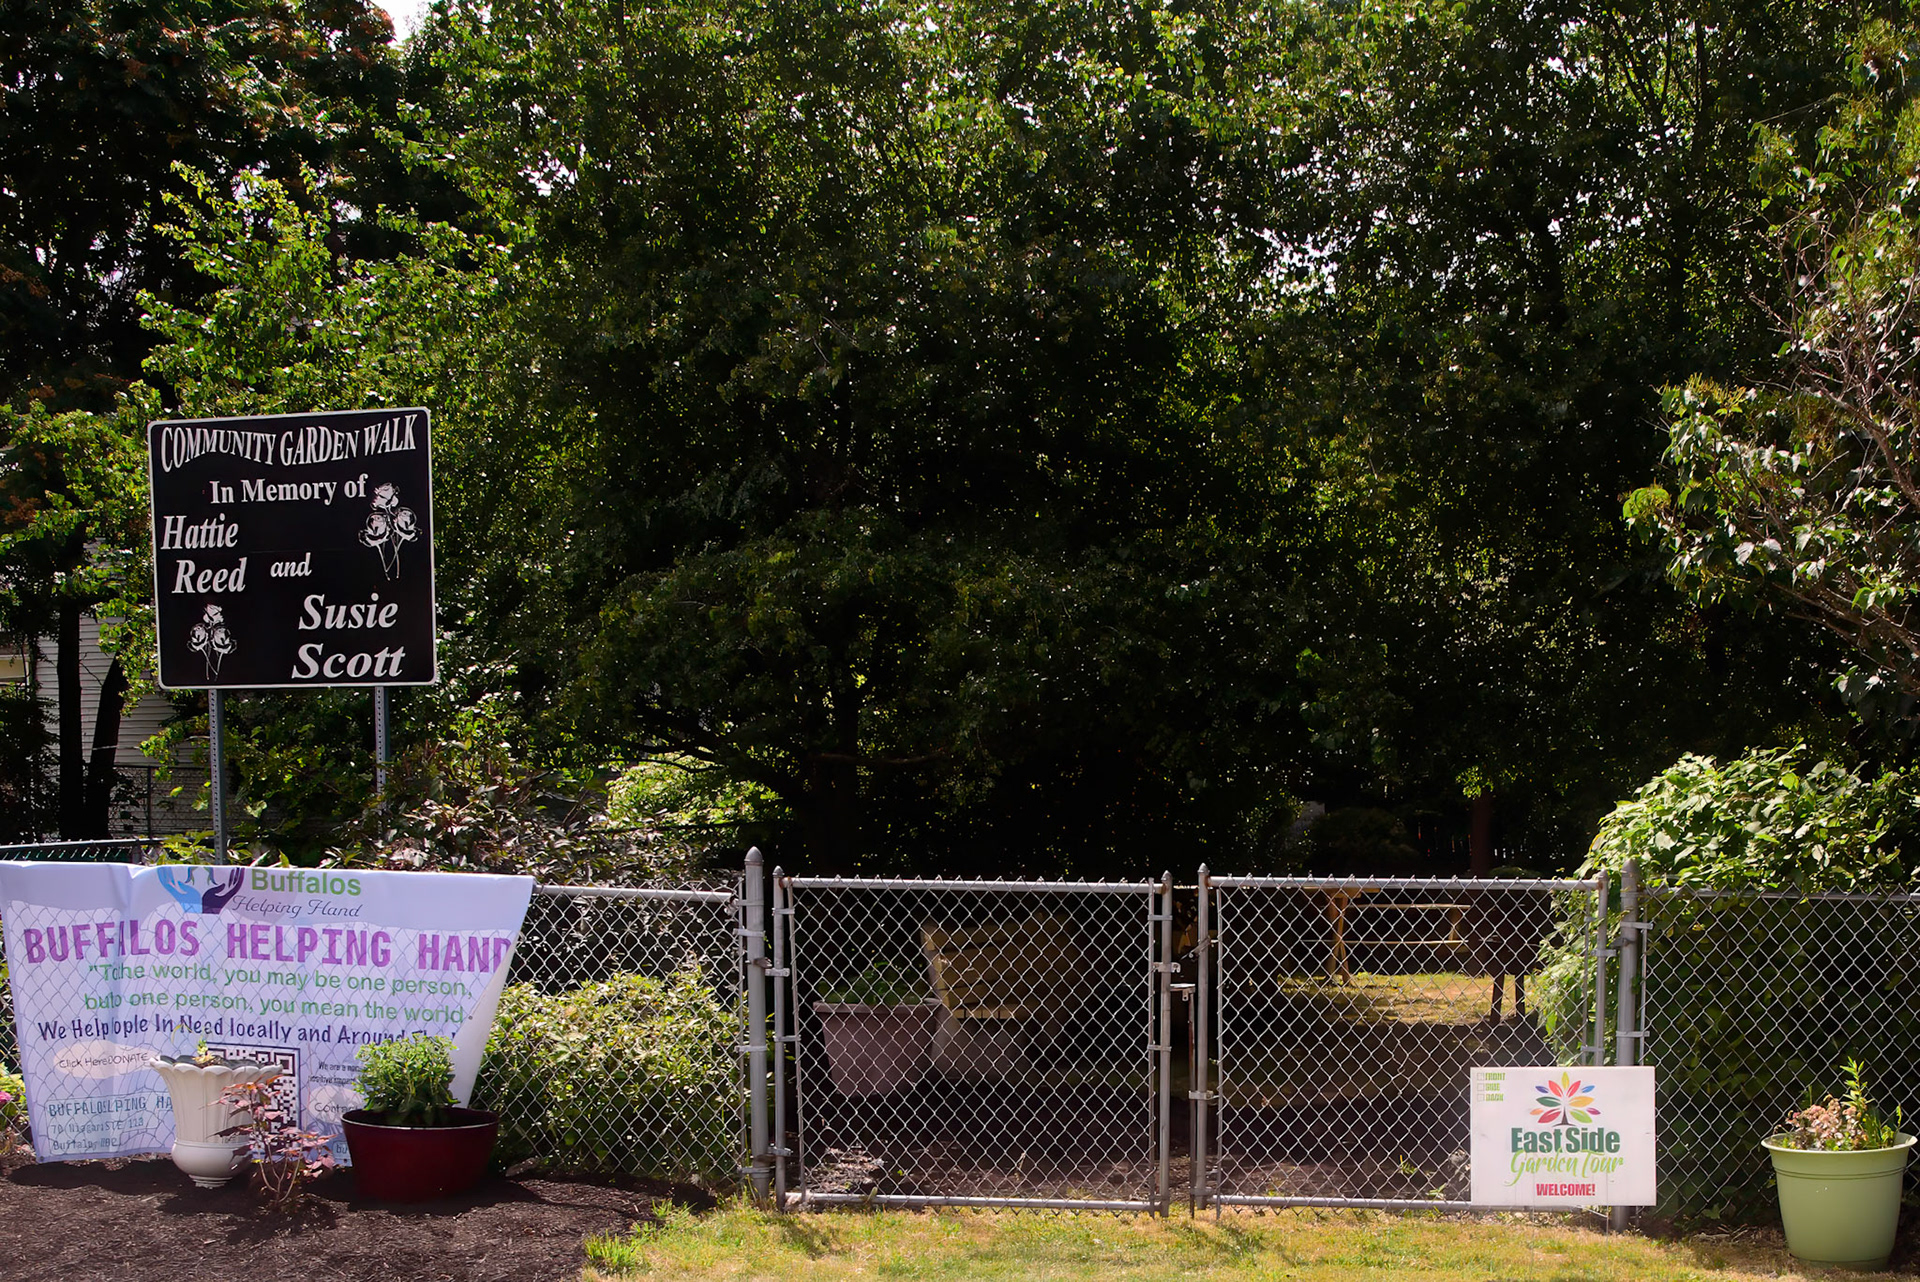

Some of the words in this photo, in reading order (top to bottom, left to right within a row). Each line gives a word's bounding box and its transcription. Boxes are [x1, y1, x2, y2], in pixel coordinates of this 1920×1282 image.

[161, 426, 276, 473] COMMUNITY
[280, 425, 359, 466] GARDEN
[363, 414, 418, 456] WALK
[209, 480, 234, 504] In
[241, 478, 337, 505] Memory
[344, 473, 368, 498] of
[160, 512, 239, 549] Hattie
[172, 557, 248, 594] Reed
[270, 552, 312, 578] and
[298, 592, 399, 630] Susie
[291, 642, 406, 679] Scott
[251, 868, 362, 896] Buffalos
[232, 895, 302, 919] Helping
[307, 899, 363, 917] Hand
[23, 919, 200, 964] BUFFALOS
[227, 923, 391, 967] HELPING
[152, 962, 217, 984] world,
[225, 967, 261, 986] you
[267, 971, 308, 991] may
[314, 970, 341, 988] be
[347, 975, 385, 991] one
[392, 978, 472, 999] person,
[129, 992, 169, 1006] one
[175, 992, 253, 1014] person,
[260, 998, 295, 1016] you
[301, 1000, 359, 1018] mean
[364, 1001, 398, 1020] the
[38, 1021, 66, 1041] We
[72, 1017, 109, 1040] Help
[155, 1013, 174, 1033] In
[180, 1015, 223, 1036] Need
[230, 1017, 291, 1043] locally
[298, 1025, 331, 1043] and
[60, 1059, 83, 1069] Click
[1485, 1072, 1505, 1081] FRONT
[156, 1095, 174, 1110] HA
[1511, 1127, 1563, 1153] East
[1566, 1127, 1620, 1153] Side
[1504, 1148, 1579, 1187] Garden
[1580, 1150, 1624, 1178] Tour
[1536, 1183, 1596, 1197] WELCOME!
